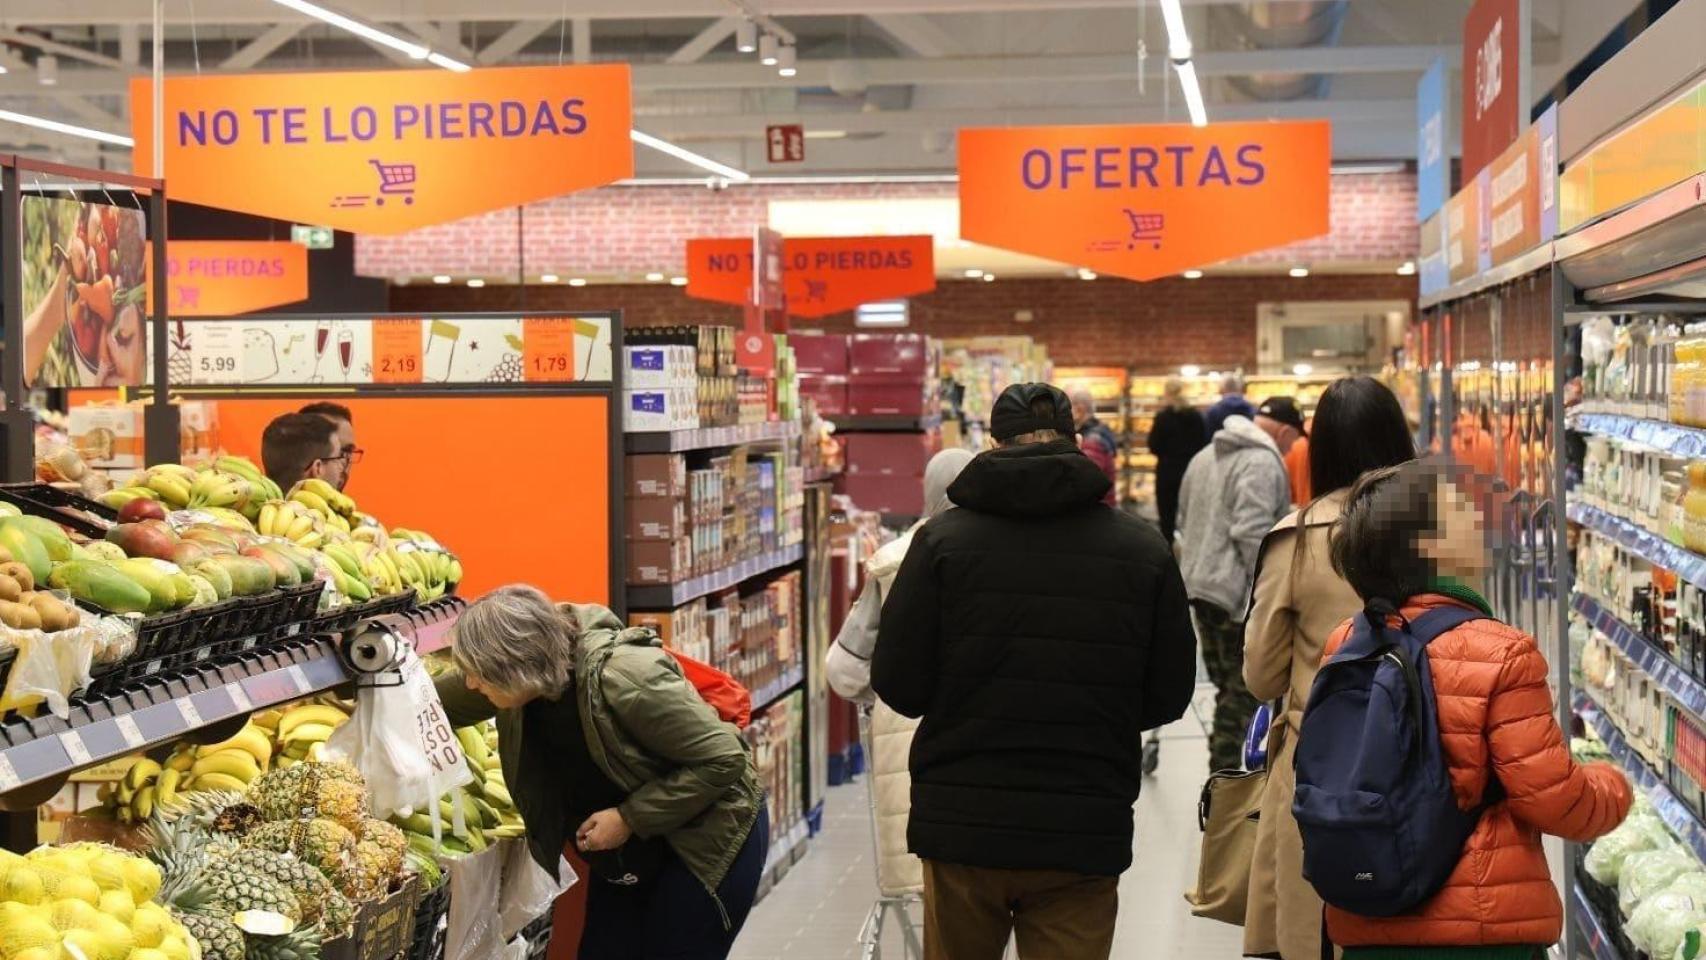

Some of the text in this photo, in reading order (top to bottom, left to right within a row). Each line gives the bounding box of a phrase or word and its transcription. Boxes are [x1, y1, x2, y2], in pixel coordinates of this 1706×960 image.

[177, 98, 588, 147] NO TE LO PIERDAS
[1021, 144, 1266, 191] OFERTAS
[188, 258, 285, 277] PIERDAS
[708, 253, 739, 272] NO
[815, 249, 913, 270] PIERDAS
[200, 356, 235, 373] 5,99
[381, 357, 416, 374] 2,19
[533, 356, 567, 373] 1,79
